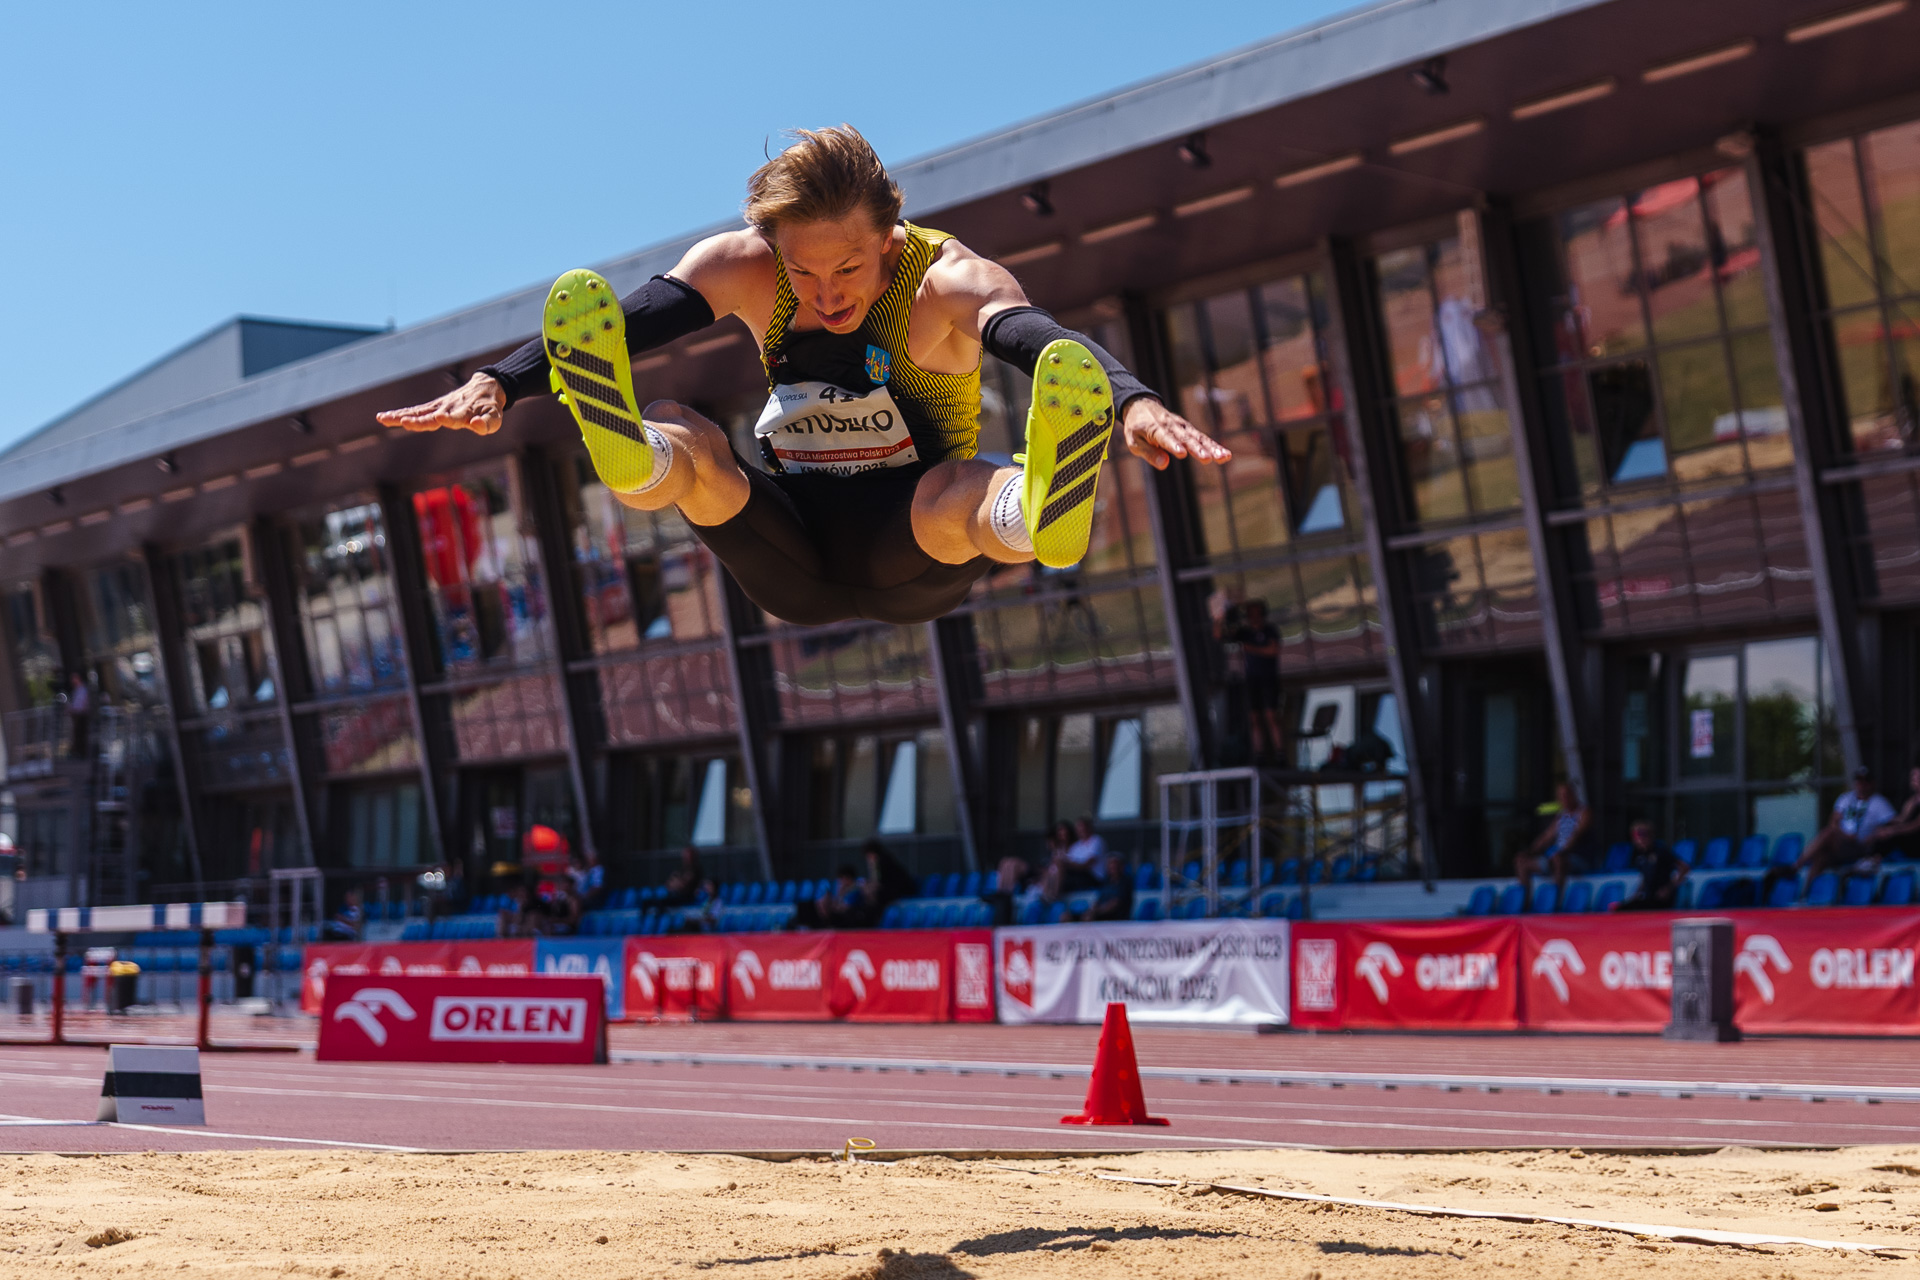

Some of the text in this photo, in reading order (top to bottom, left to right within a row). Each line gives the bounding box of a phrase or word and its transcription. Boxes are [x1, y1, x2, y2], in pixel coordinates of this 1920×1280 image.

[772, 409, 894, 434] IETUSZKO
[795, 452, 812, 460] PZLA
[812, 452, 858, 460] Mistrzostwa
[859, 449, 883, 458] Polski
[884, 445, 900, 456] U23
[1415, 952, 1499, 990] ORLEN
[1601, 951, 1673, 990] ORLE
[1809, 948, 1915, 989] ORLEN
[443, 1006, 573, 1032] ORLEN
